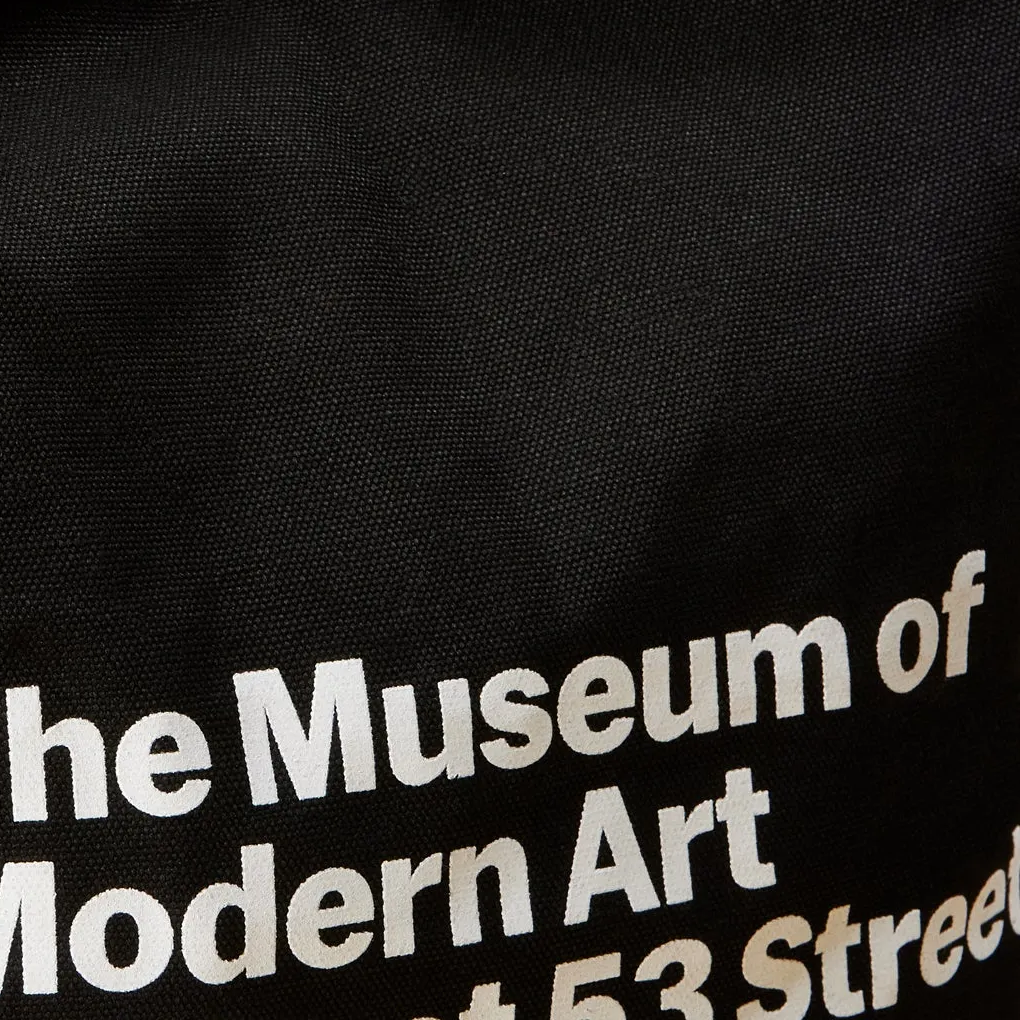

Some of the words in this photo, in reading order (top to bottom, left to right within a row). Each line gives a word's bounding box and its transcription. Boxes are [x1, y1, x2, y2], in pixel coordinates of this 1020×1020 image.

[232, 615, 852, 807] Museum
[875, 549, 986, 694] of
[563, 767, 777, 927] Art
[549, 938, 714, 1020] 53
